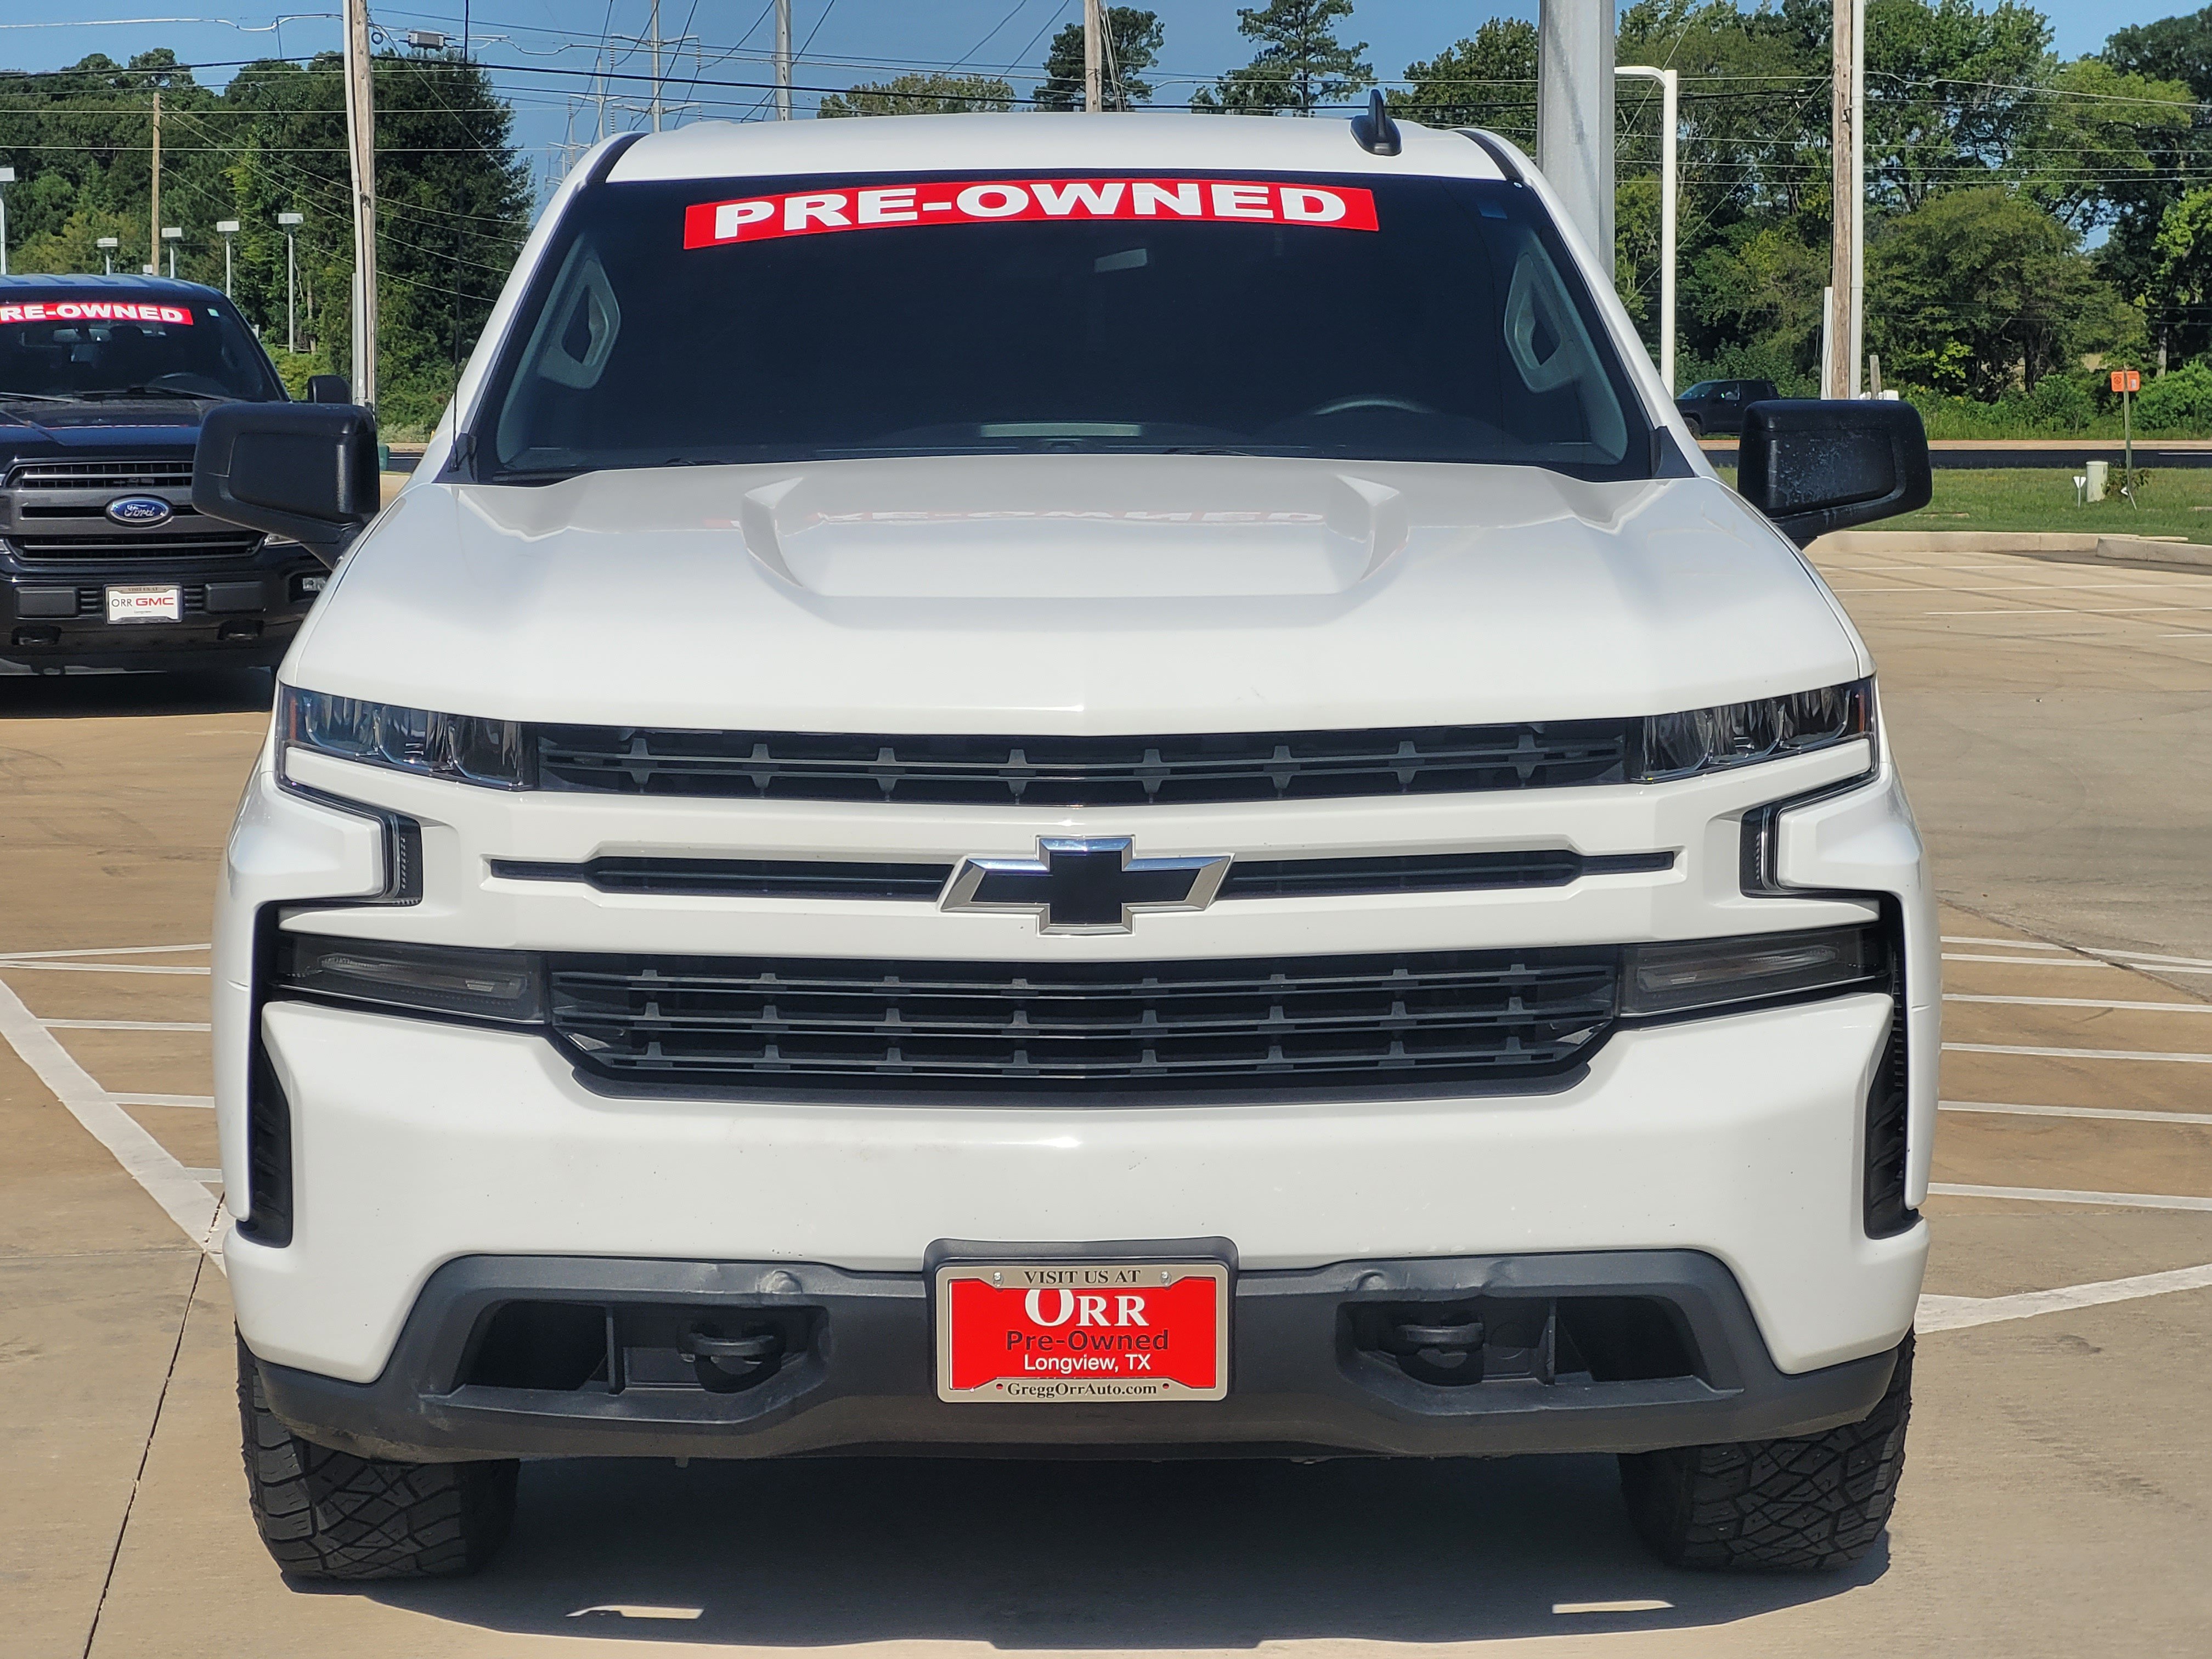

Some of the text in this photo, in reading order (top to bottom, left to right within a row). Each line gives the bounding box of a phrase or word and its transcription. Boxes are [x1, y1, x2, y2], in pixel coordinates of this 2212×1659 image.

[714, 182, 1347, 240] PRE-OWNED
[124, 504, 155, 517] Ford
[111, 597, 174, 607] ORR GMC
[1024, 1270, 1141, 1284] VISIT US AT
[1007, 1329, 1169, 1351] Pre-Owned
[1024, 1353, 1152, 1374] Longview, TX
[1007, 1383, 1157, 1399] GreggOrrAuto.com
